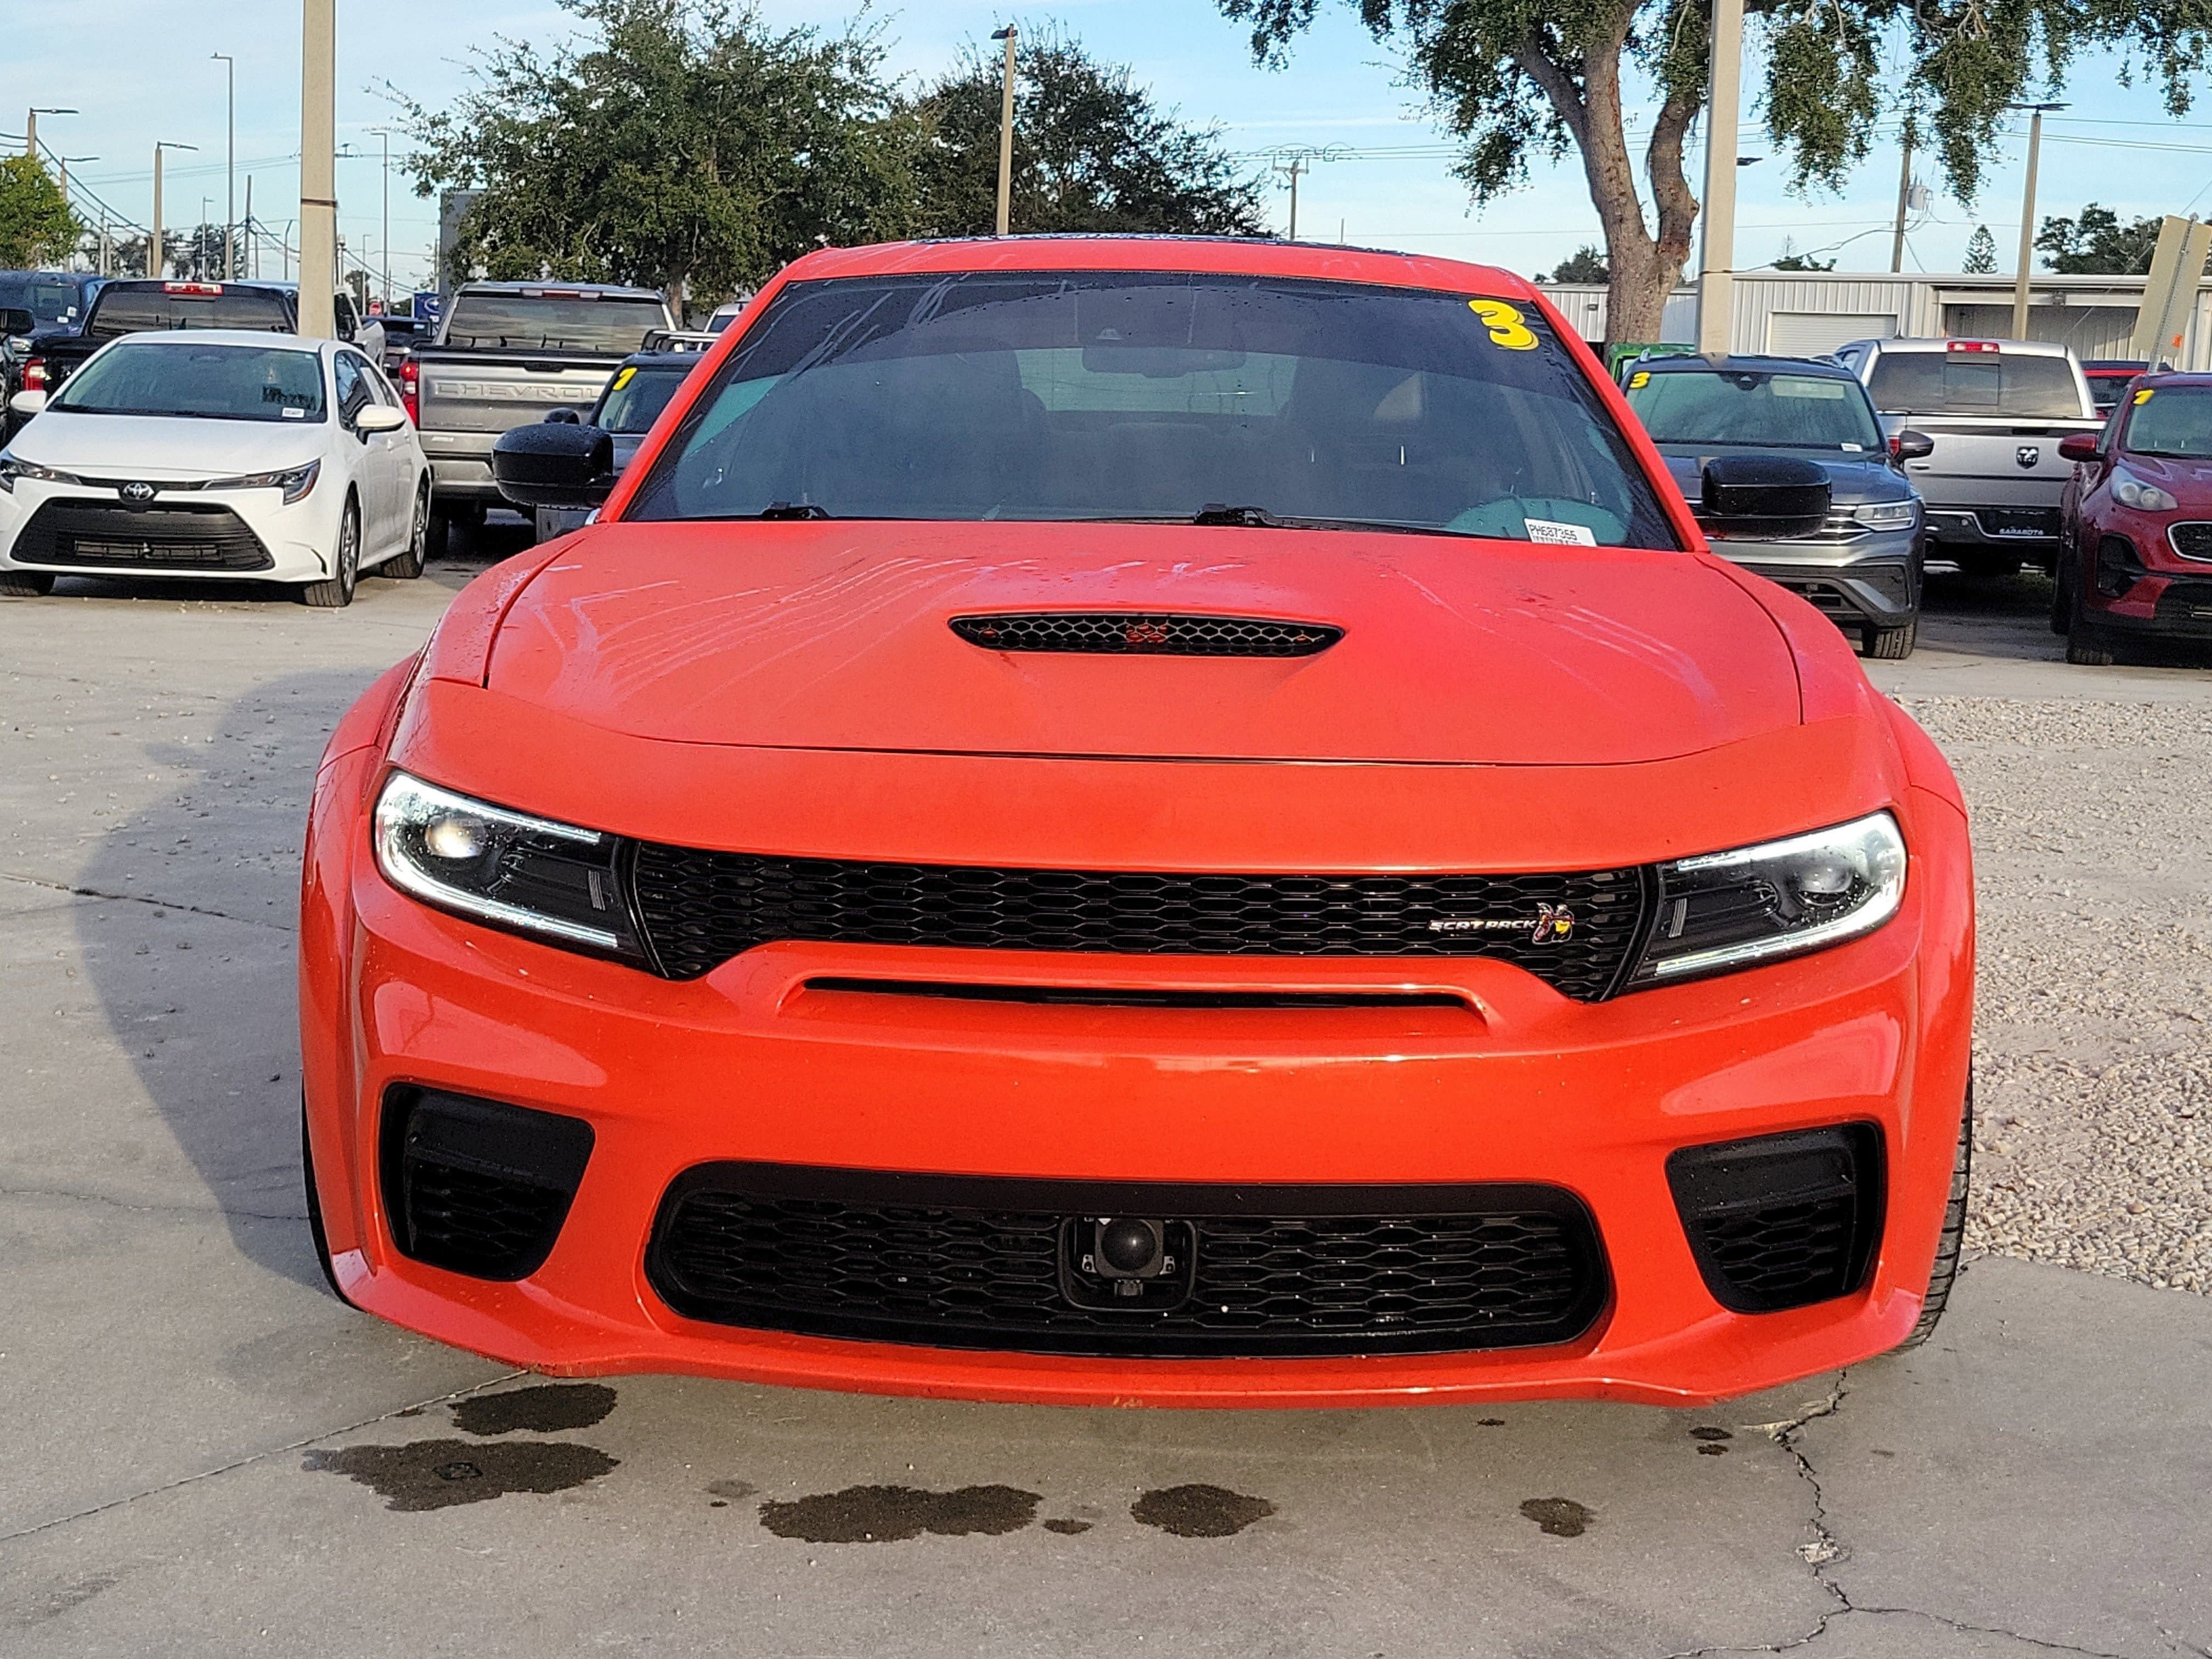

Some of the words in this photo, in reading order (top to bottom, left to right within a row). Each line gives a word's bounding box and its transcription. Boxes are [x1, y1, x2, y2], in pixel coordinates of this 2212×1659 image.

[1468, 300, 1539, 350] 3
[1630, 371, 1651, 388] 3
[435, 382, 601, 398] CHEVROL
[1429, 920, 1483, 932] SCAT
[1485, 919, 1537, 929] PACK
